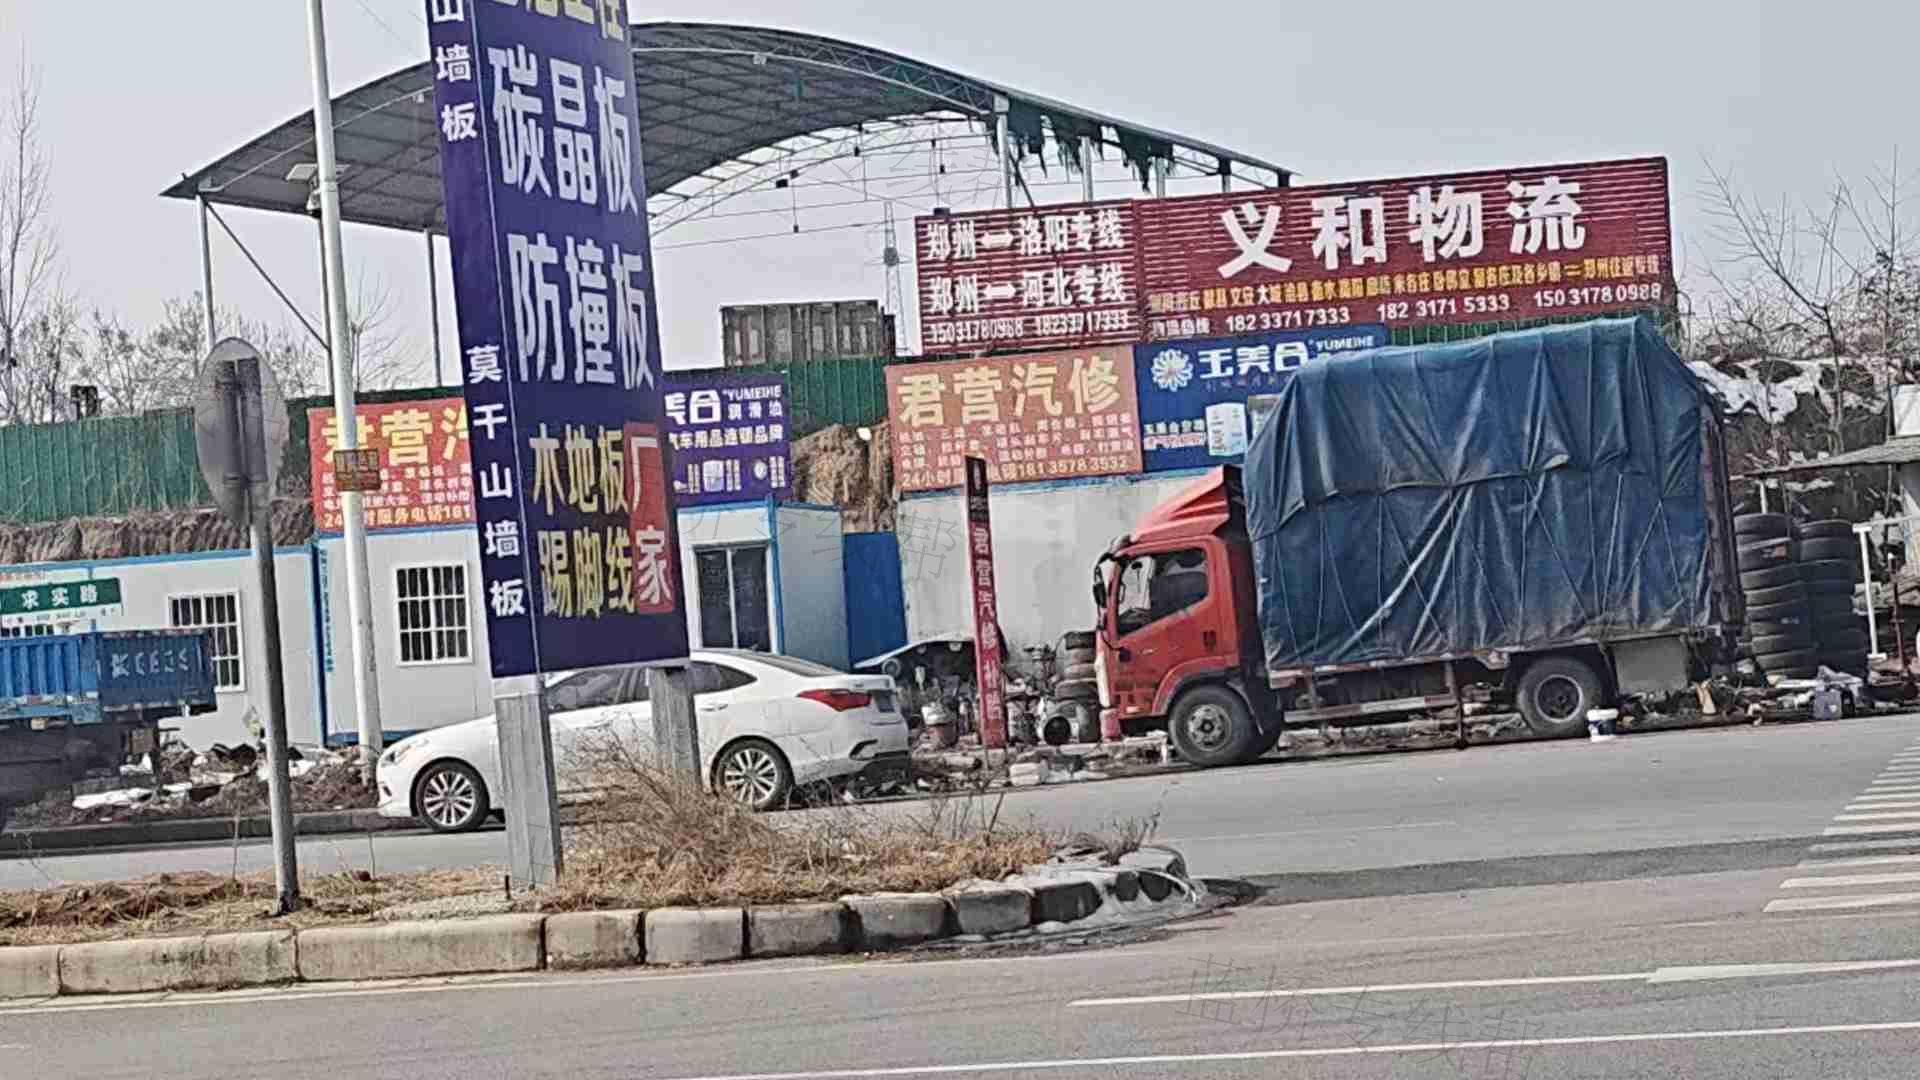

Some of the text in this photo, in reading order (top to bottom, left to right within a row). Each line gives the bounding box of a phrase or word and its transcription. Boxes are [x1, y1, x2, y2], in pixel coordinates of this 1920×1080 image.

[487, 44, 638, 216] 碳晶板
[926, 208, 1125, 260] 郑州 洛阳专线
[1217, 176, 1586, 279] 义和物流
[507, 232, 654, 390] 防撞板
[928, 262, 1127, 314] 郑州 河北专线
[897, 355, 1121, 428] 君营汽修
[466, 344, 527, 617] 莫干山墙板
[529, 422, 629, 516] 木地板
[628, 436, 674, 605] 厂家
[537, 526, 636, 620] 踢脚线
